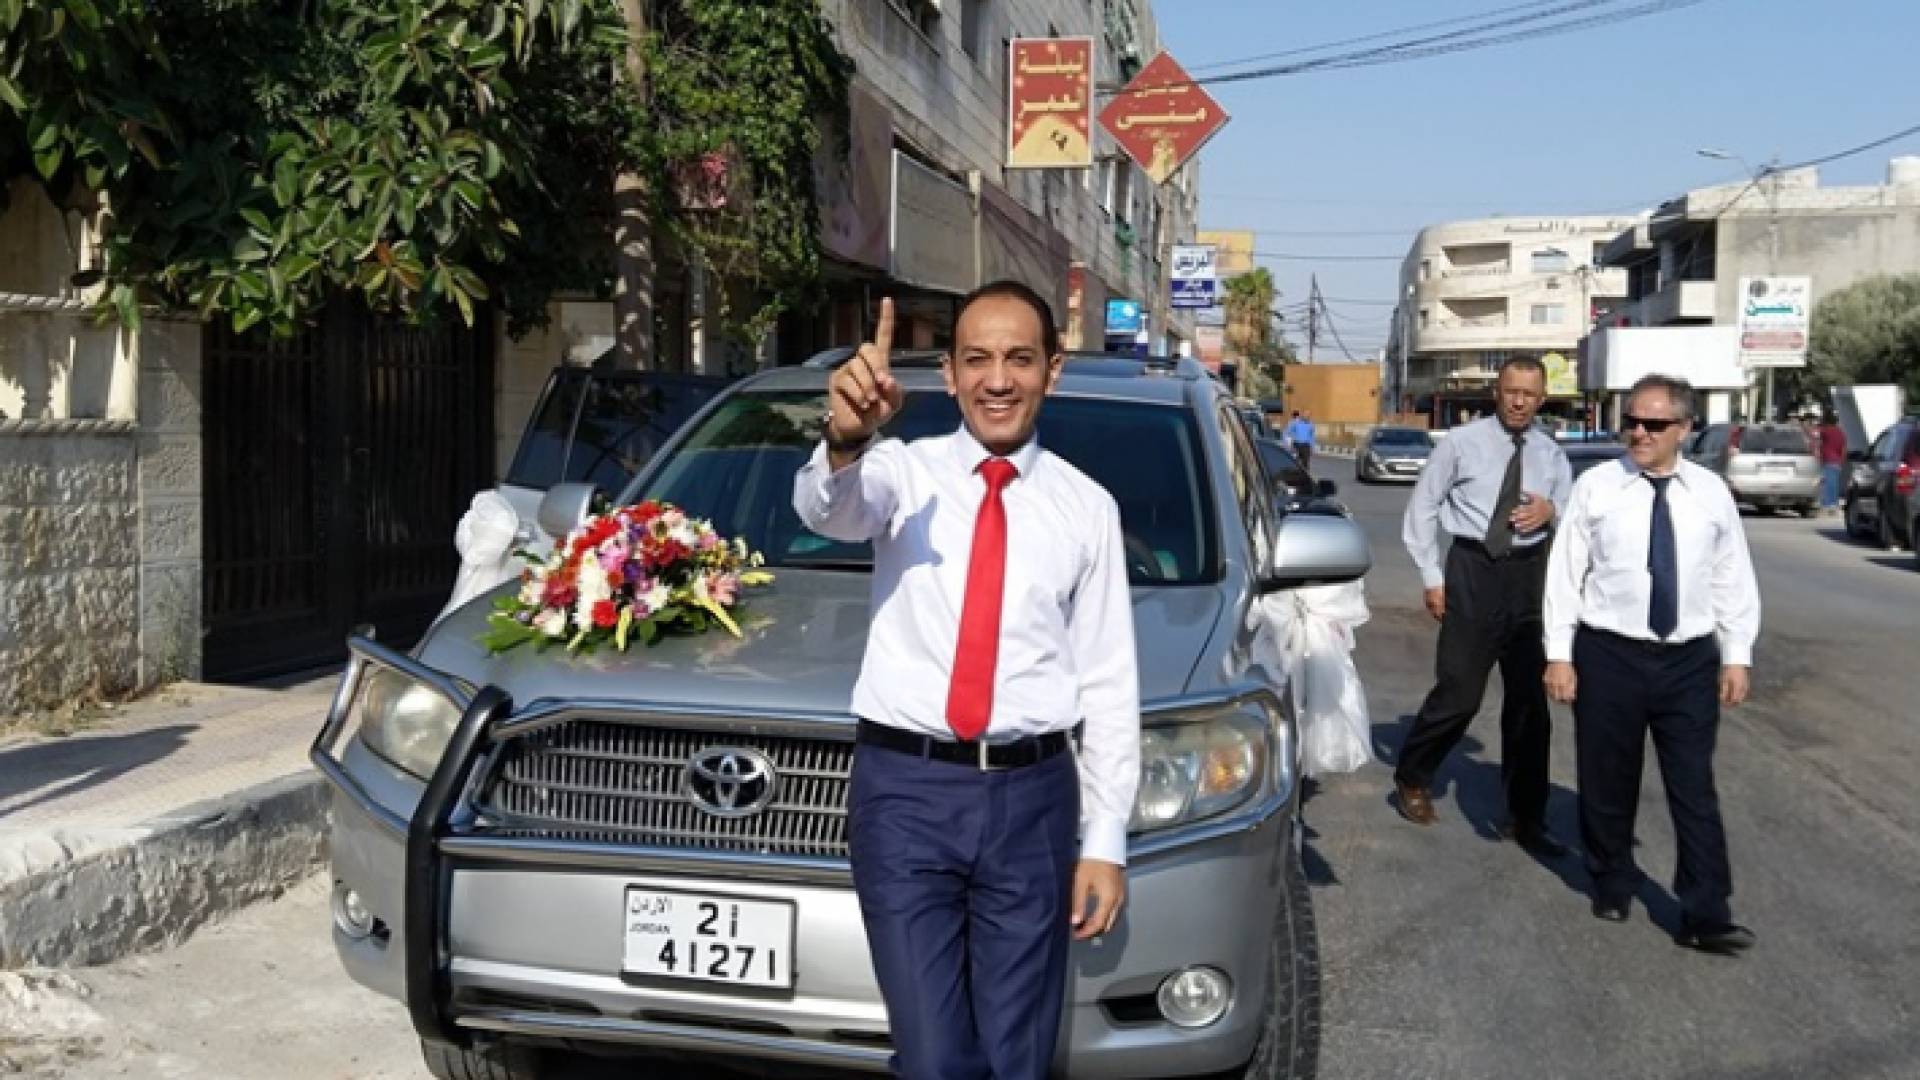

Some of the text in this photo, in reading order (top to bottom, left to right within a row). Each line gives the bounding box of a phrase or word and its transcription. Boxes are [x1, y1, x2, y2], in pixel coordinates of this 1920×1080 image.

[629, 922, 671, 934] JORDAN
[696, 901, 739, 938] 21
[658, 938, 776, 980] 41271
